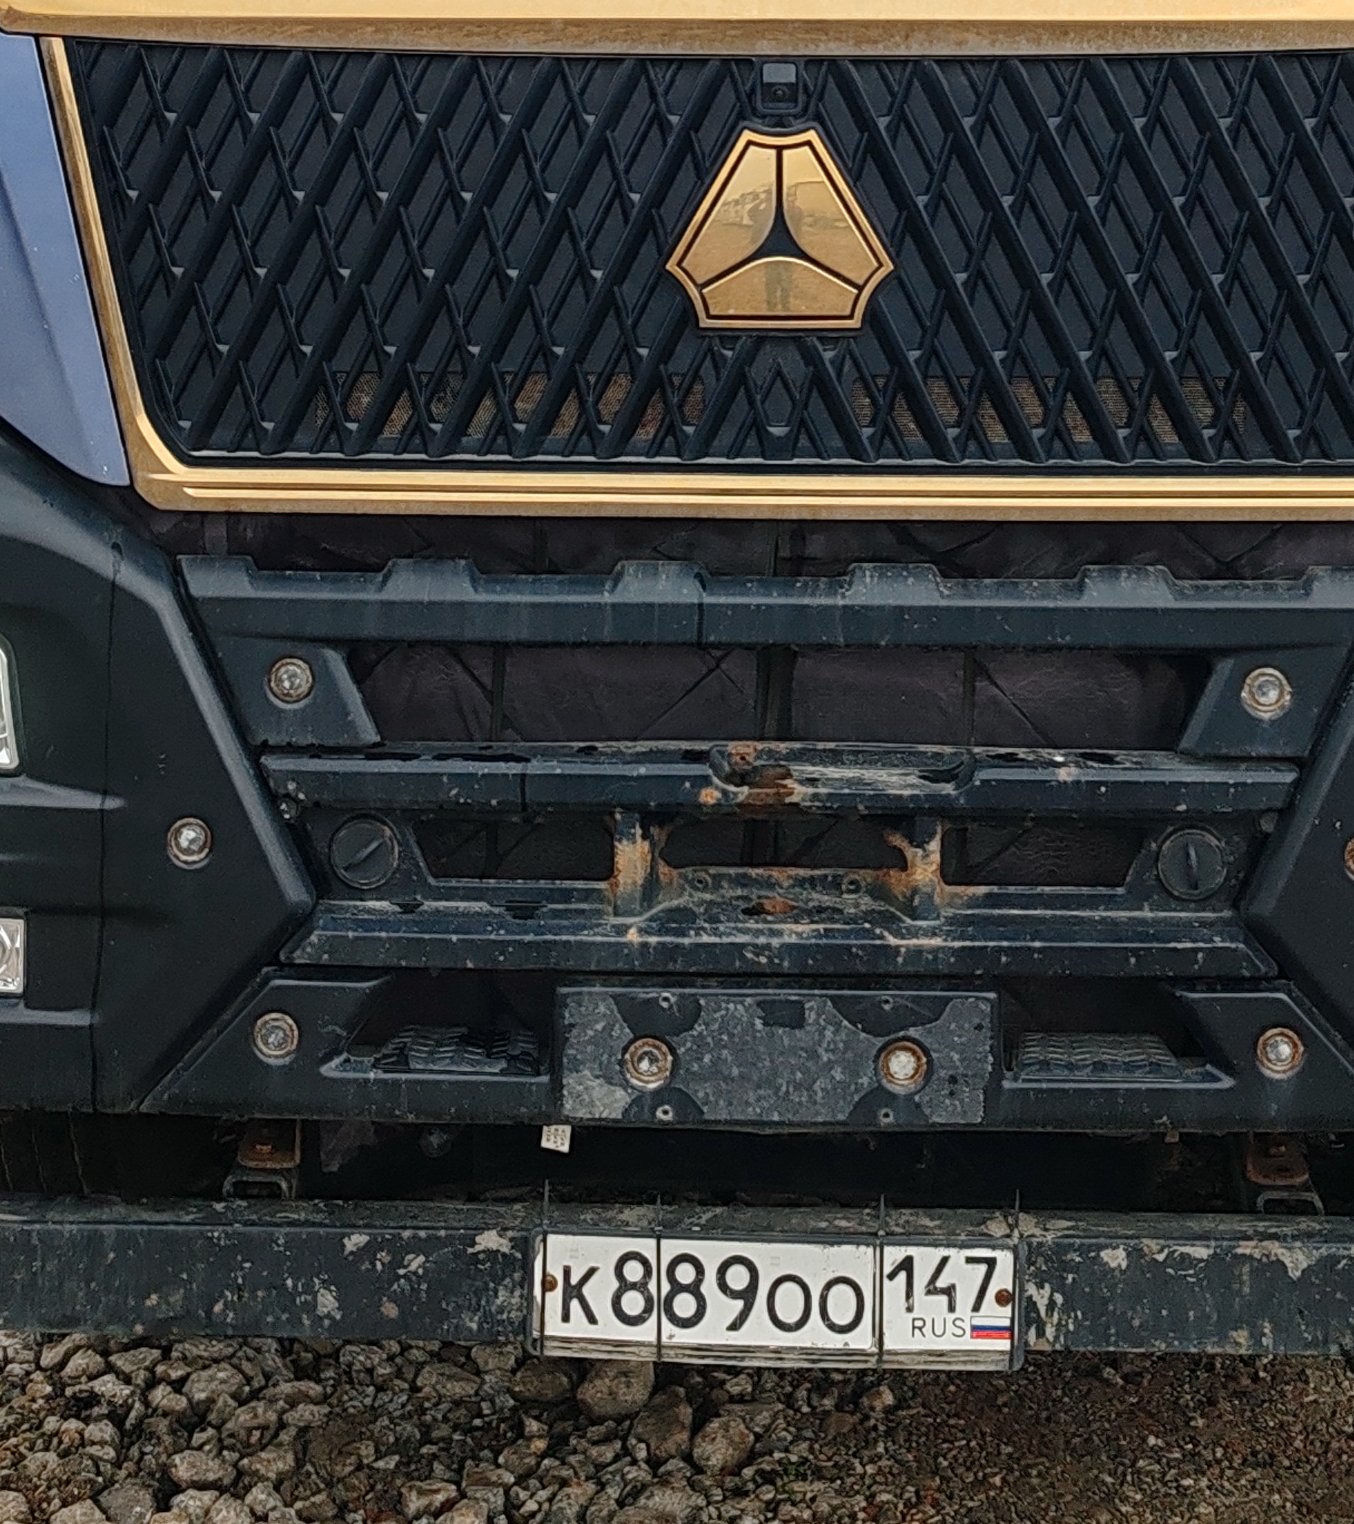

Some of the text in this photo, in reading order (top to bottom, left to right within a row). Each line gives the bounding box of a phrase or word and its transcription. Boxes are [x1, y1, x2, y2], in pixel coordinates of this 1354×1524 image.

[560, 1249, 998, 1335] K889OO 147
[911, 1316, 967, 1340] RUS
